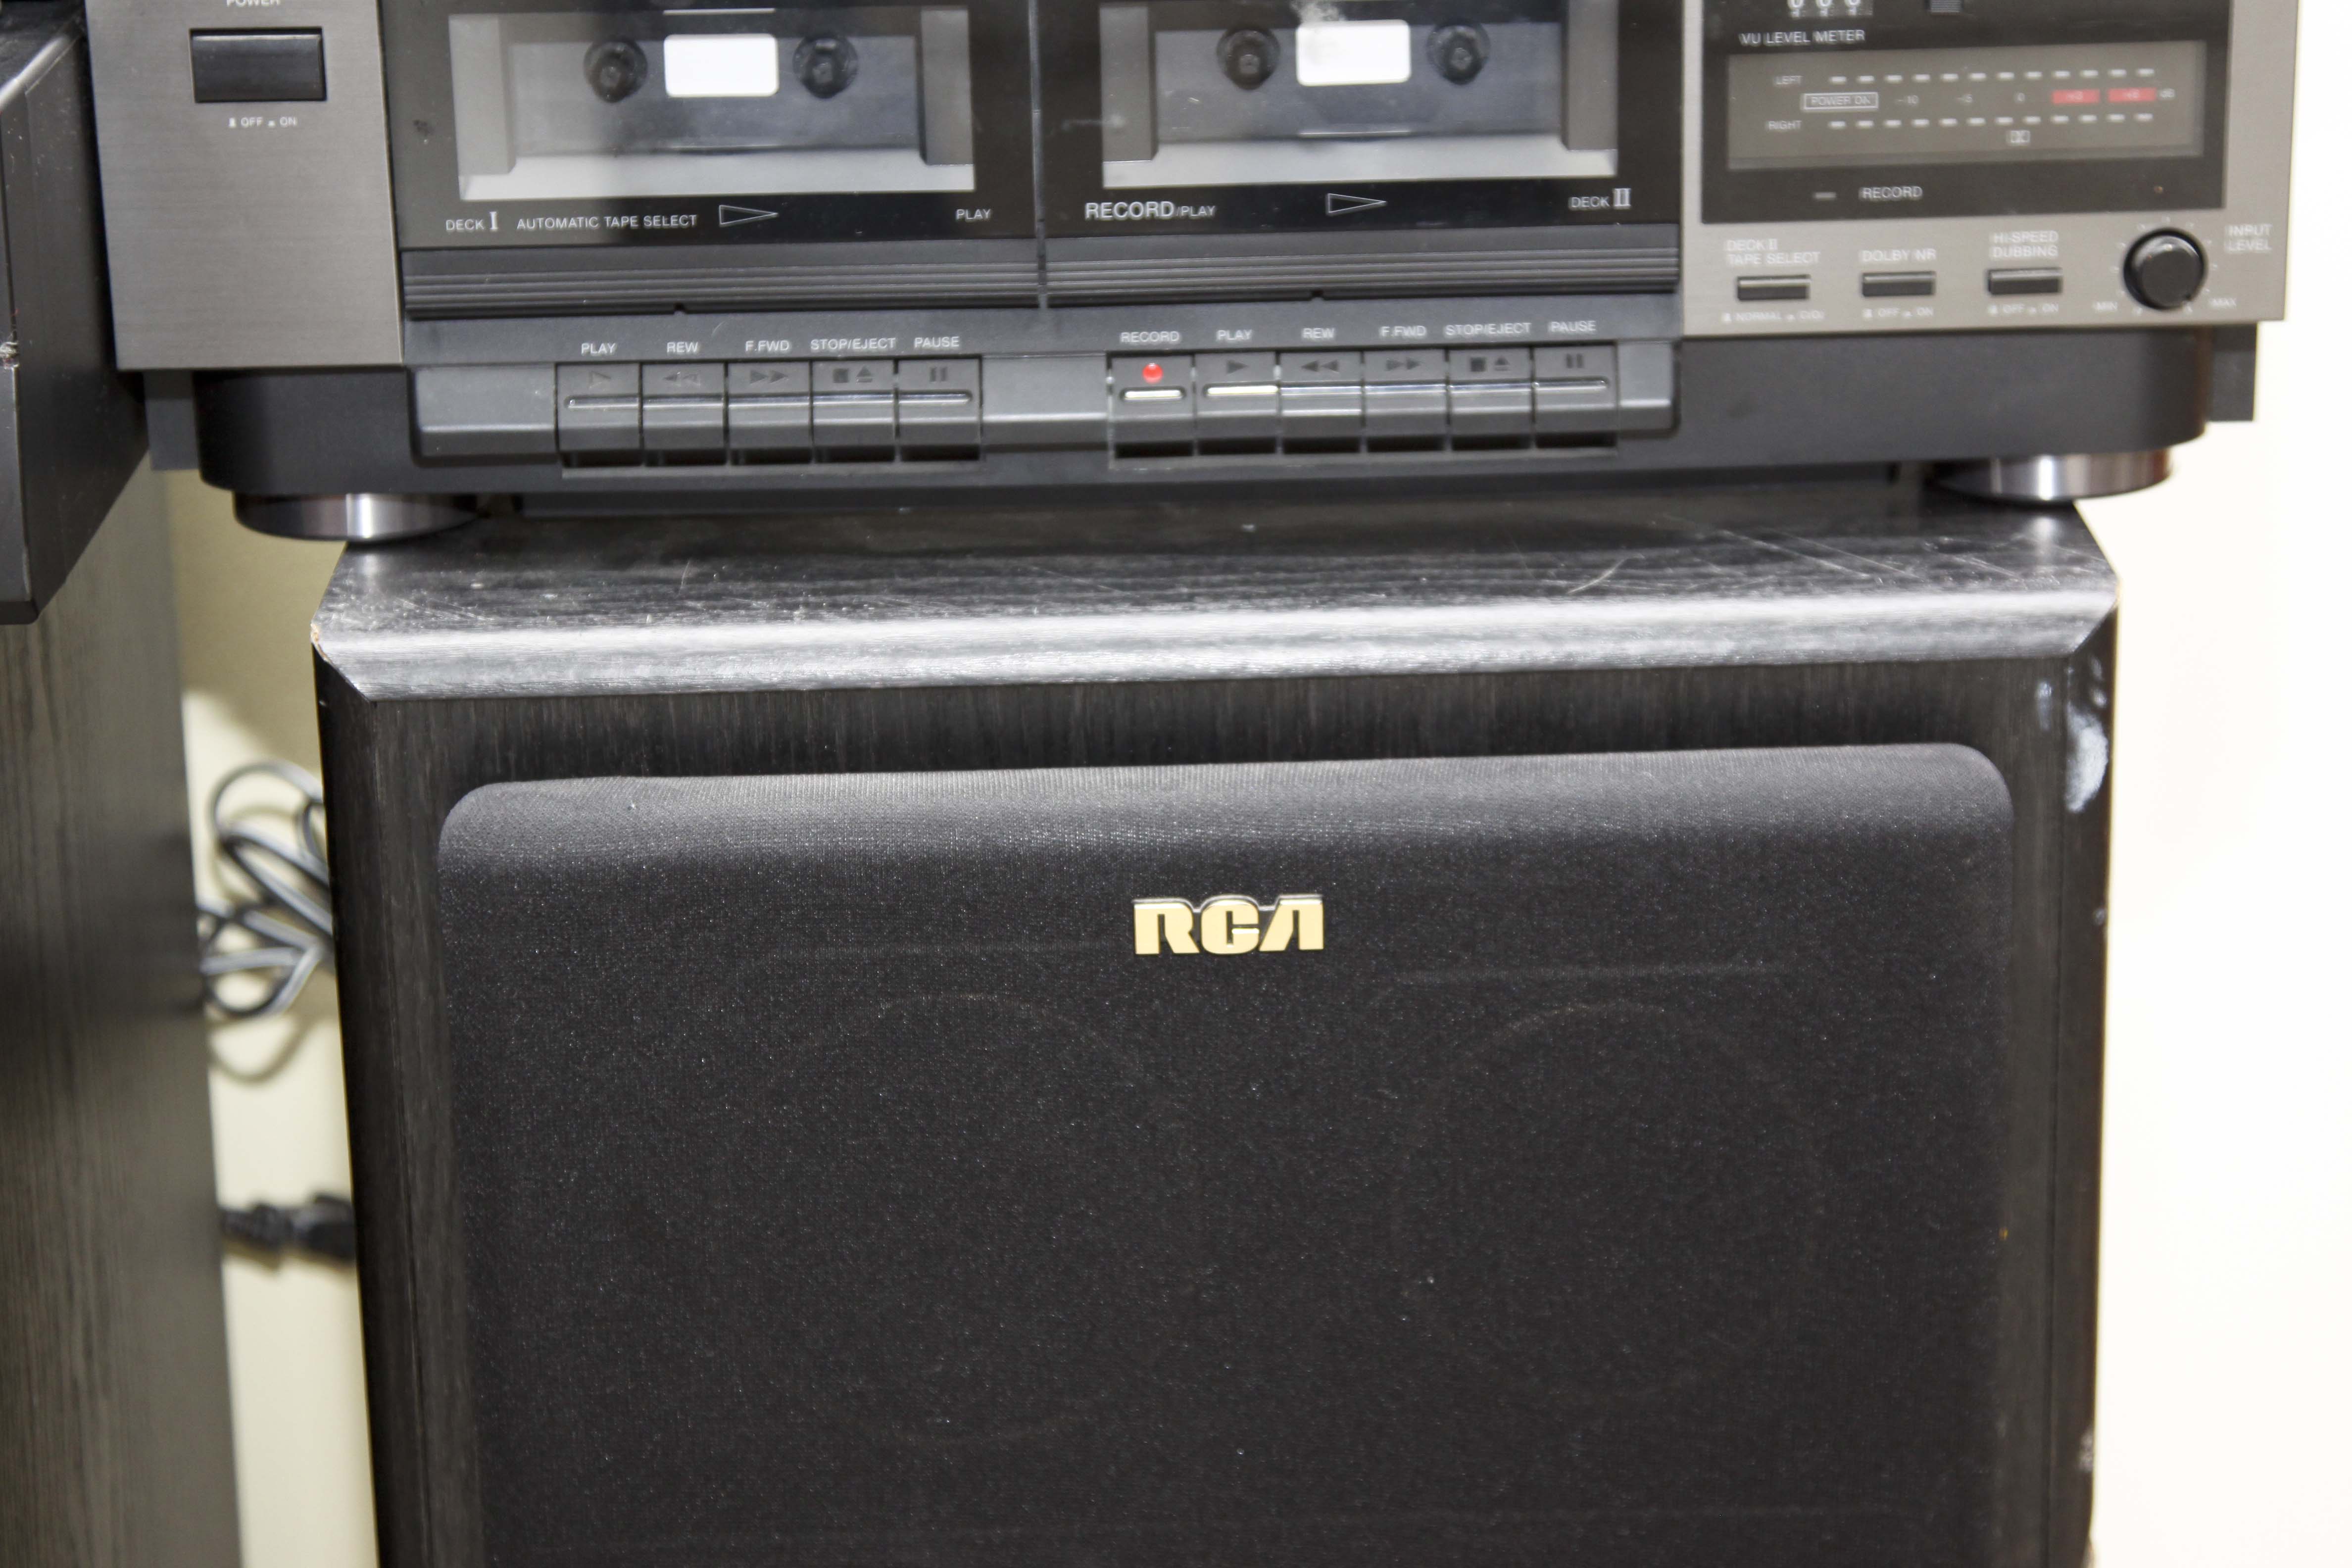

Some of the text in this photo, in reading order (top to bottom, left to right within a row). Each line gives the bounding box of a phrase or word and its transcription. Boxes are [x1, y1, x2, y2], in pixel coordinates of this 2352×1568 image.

[1739, 30, 1865, 45] VU LEVEL METER
[1774, 75, 1803, 86] LEFT
[1810, 96, 1871, 106] POWER ON
[241, 116, 297, 126] OFF ON
[1767, 120, 1802, 131] RIGHT
[1860, 187, 1922, 200] RECORD
[1568, 196, 1610, 208] DECK
[955, 208, 991, 220] PLAY
[446, 219, 485, 231] DECK
[516, 214, 697, 230] AUTOMATIC TAPE SELECT
[2226, 224, 2272, 237] INPUT
[1990, 231, 2059, 244] HI-SPEED
[1726, 239, 1765, 251] DECK
[1990, 245, 2058, 258] DUBBING
[2226, 239, 2272, 251] LEVEL
[1726, 251, 1821, 265] TAPE SELECT
[1860, 248, 1937, 263] DOLBY NR
[2003, 303, 2059, 314] OFF ON
[2093, 297, 2236, 311] MIN MAX
[1735, 311, 1782, 321] NORMAL
[1877, 307, 1933, 318] OFF ON
[1301, 327, 1335, 340] REW
[1379, 325, 1427, 338] F.FWD
[1444, 322, 1532, 336] STOP/EJECT
[1548, 320, 1597, 334] PAUSE
[1120, 331, 1181, 343] RECORD
[1216, 329, 1253, 342] PLAY
[581, 342, 617, 355] PLAY
[666, 341, 699, 354] REW
[745, 339, 790, 353] F.FWD
[810, 337, 896, 350] STOP/EJECT
[914, 336, 960, 349] PAUSE
[1132, 895, 1324, 955] RCA
